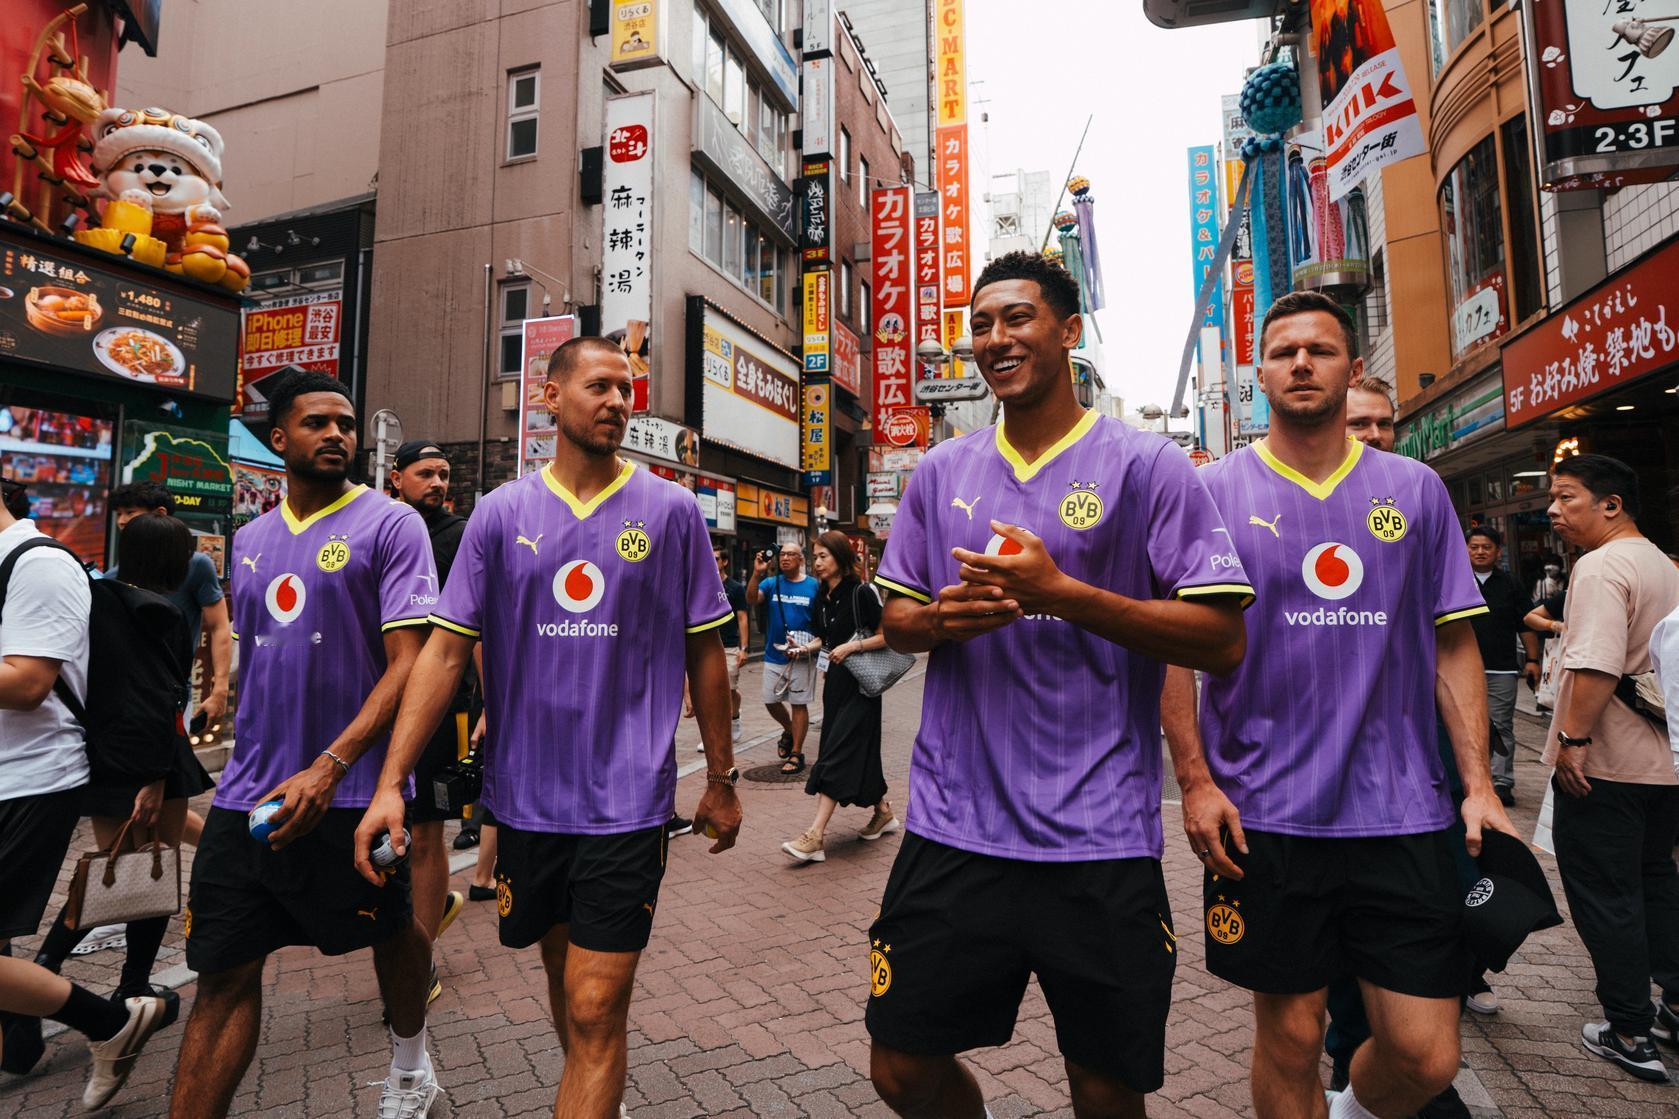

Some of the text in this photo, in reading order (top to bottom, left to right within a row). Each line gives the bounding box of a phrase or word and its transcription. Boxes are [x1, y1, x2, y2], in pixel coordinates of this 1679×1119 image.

[946, 138, 963, 293] カラオケ歌広場
[608, 185, 633, 294] 麻辣湯
[635, 197, 646, 277] マーラータン
[806, 249, 825, 259] 3F
[876, 190, 906, 310] カラオケ
[920, 218, 936, 281] カラオケ
[20, 254, 92, 285] 精選組合
[121, 290, 161, 308] ¥1,480
[247, 312, 304, 332] iPhone
[310, 308, 334, 323] 渋谷
[246, 328, 302, 352] 即日修理
[308, 325, 332, 340] 最安
[246, 346, 336, 367] 今すぐ修理できます
[808, 356, 825, 368] 2F
[1510, 305, 1679, 413] 5F お好み焼・築地も
[737, 355, 796, 414] 全身もみほぐし
[920, 382, 981, 394] 渋谷センター街
[809, 410, 824, 443] 松屋
[890, 423, 915, 437] 消火栓
[166, 478, 232, 492] NIGHT MARKET
[775, 497, 790, 518] 松屋
[1065, 494, 1098, 518] BVB
[1073, 516, 1085, 526] 09
[1373, 510, 1403, 532] BVB
[621, 533, 647, 553] BVB
[1383, 529, 1395, 538] 09
[321, 544, 346, 563] BVB
[628, 550, 638, 559] 09
[325, 561, 336, 569] 09
[1285, 607, 1387, 625] vodafone
[537, 619, 619, 637] vodafone
[1211, 908, 1241, 936] BVB
[1217, 929, 1229, 940] 09
